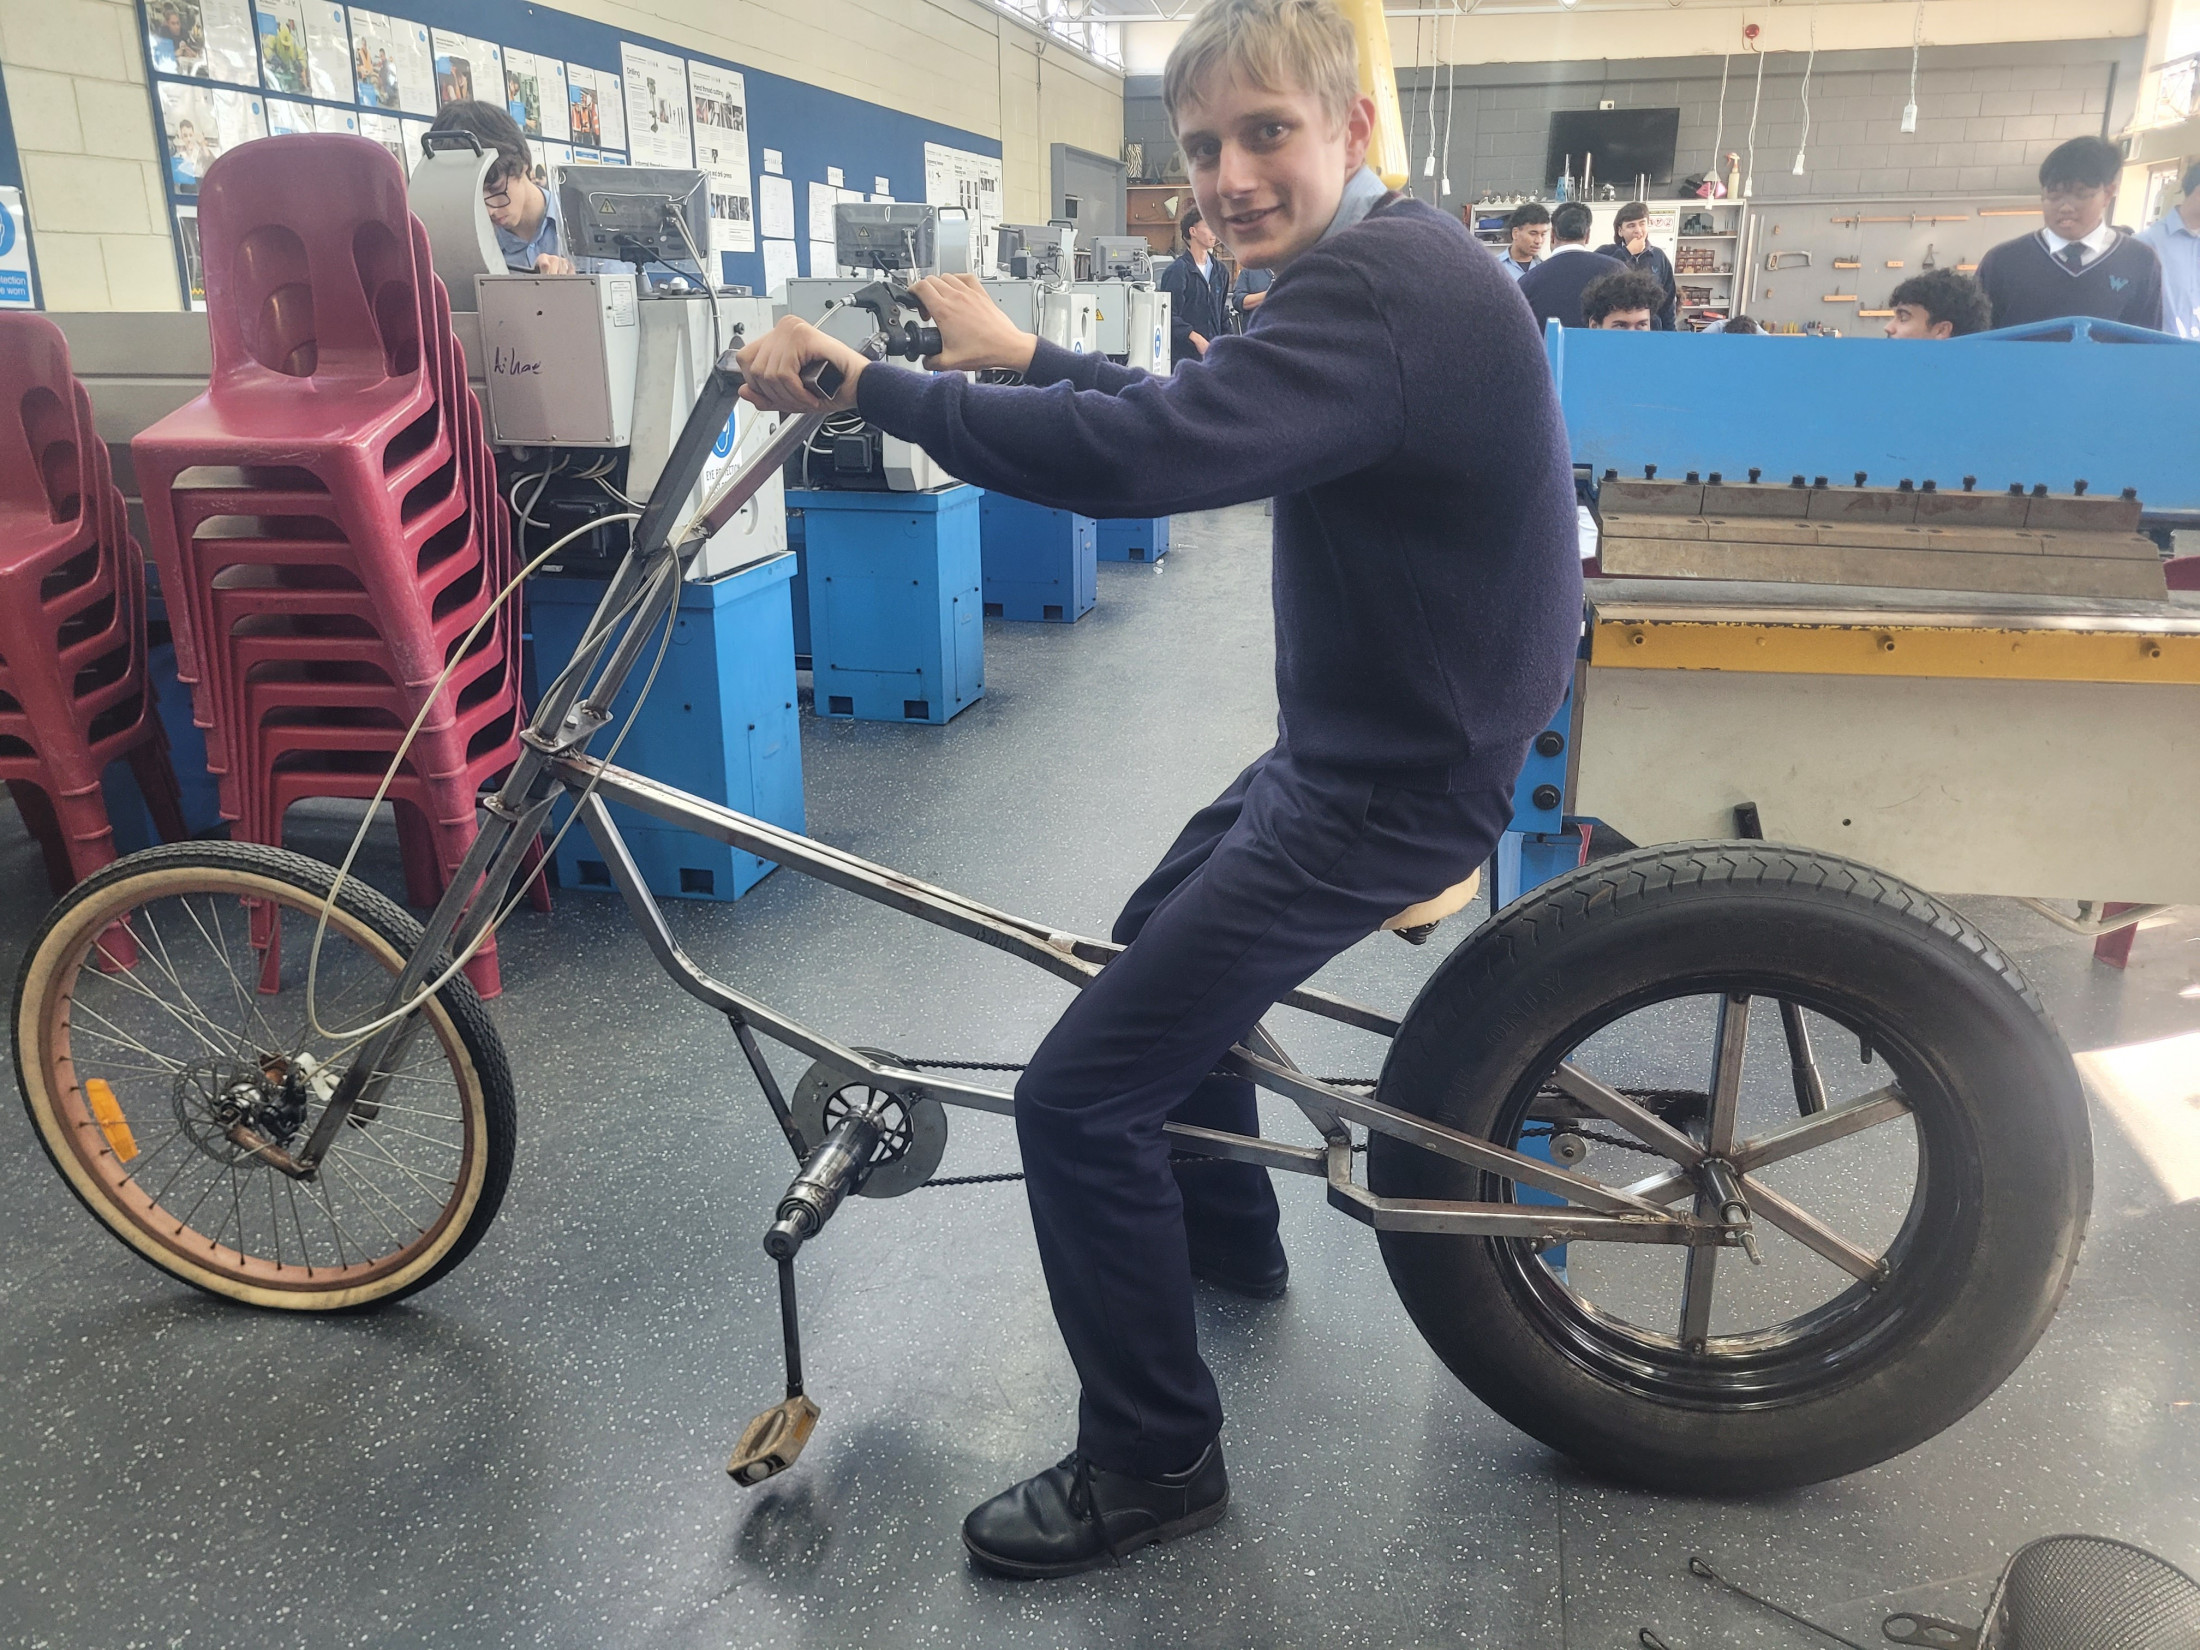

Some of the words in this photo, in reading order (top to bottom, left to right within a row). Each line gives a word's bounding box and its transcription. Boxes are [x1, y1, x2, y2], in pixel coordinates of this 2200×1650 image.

[626, 67, 641, 79] Drilling
[6, 287, 26, 296] worn
[706, 469, 716, 481] EYE
